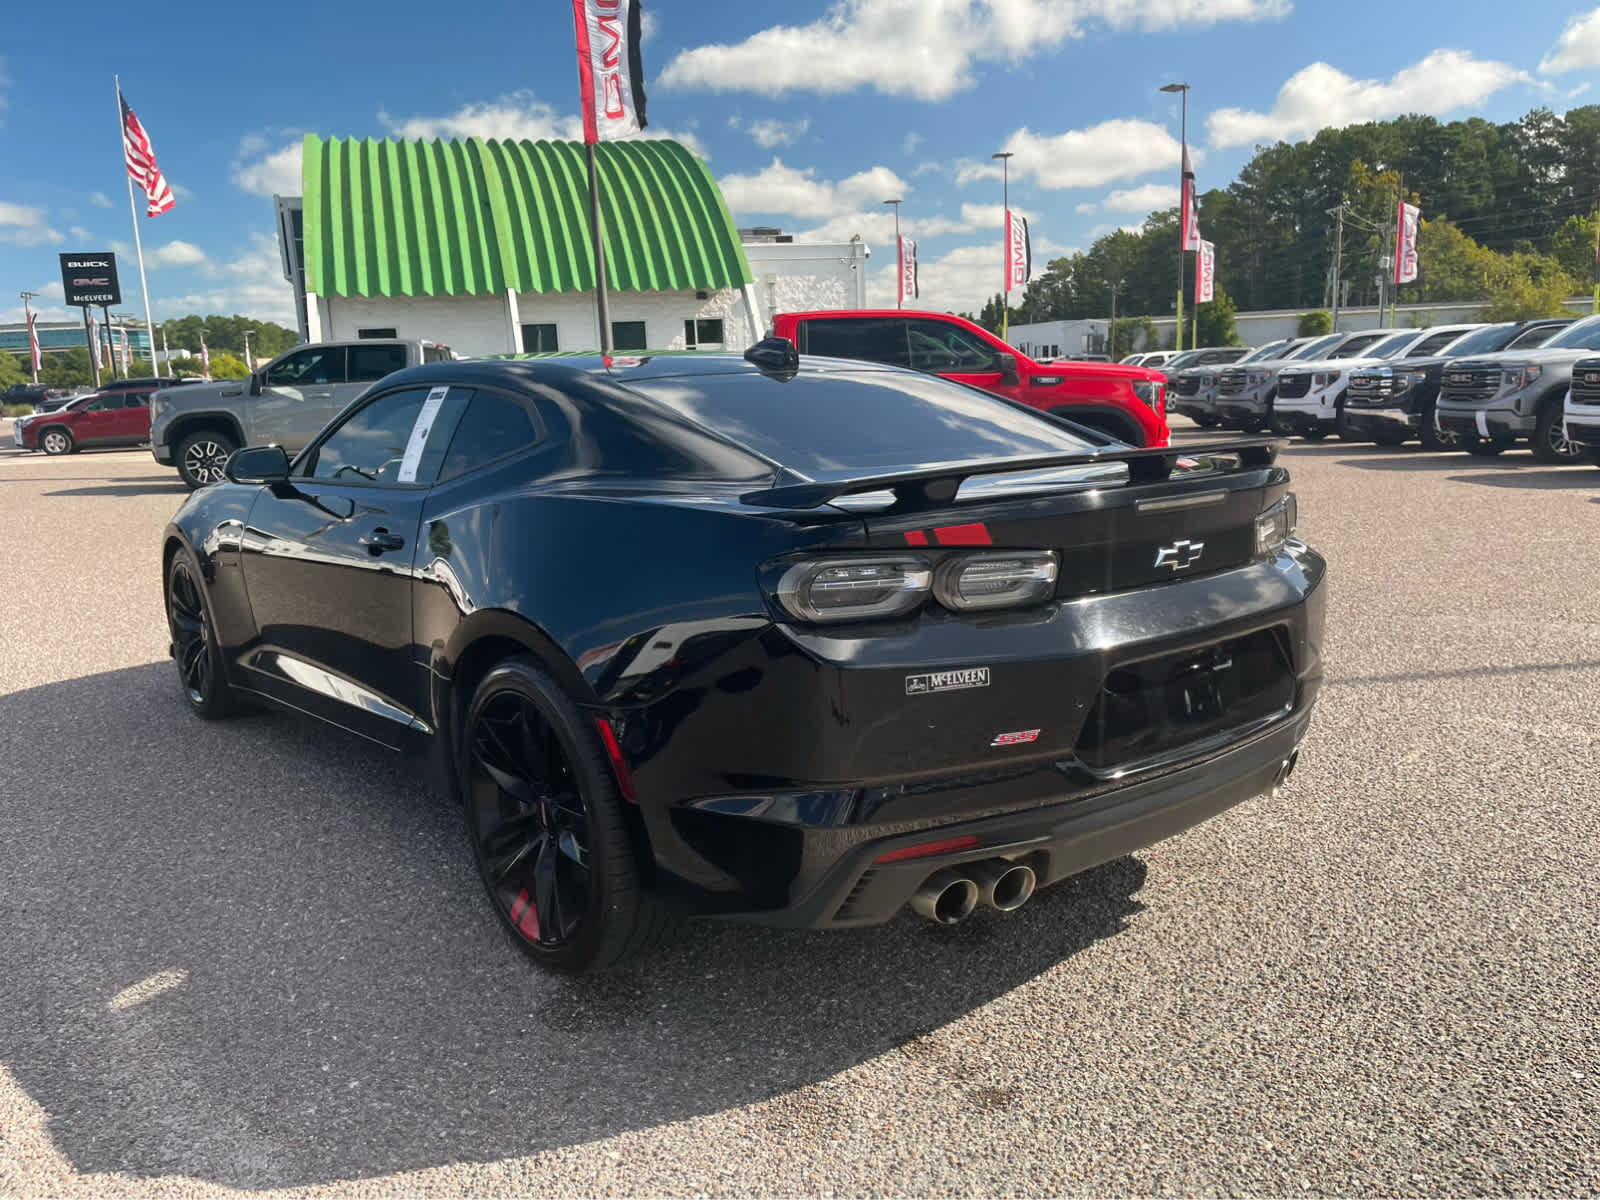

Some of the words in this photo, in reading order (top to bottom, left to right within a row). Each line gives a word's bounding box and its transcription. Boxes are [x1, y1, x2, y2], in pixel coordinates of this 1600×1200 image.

[596, 0, 625, 119] GM
[73, 278, 109, 286] GMC
[1014, 228, 1025, 284] GMC
